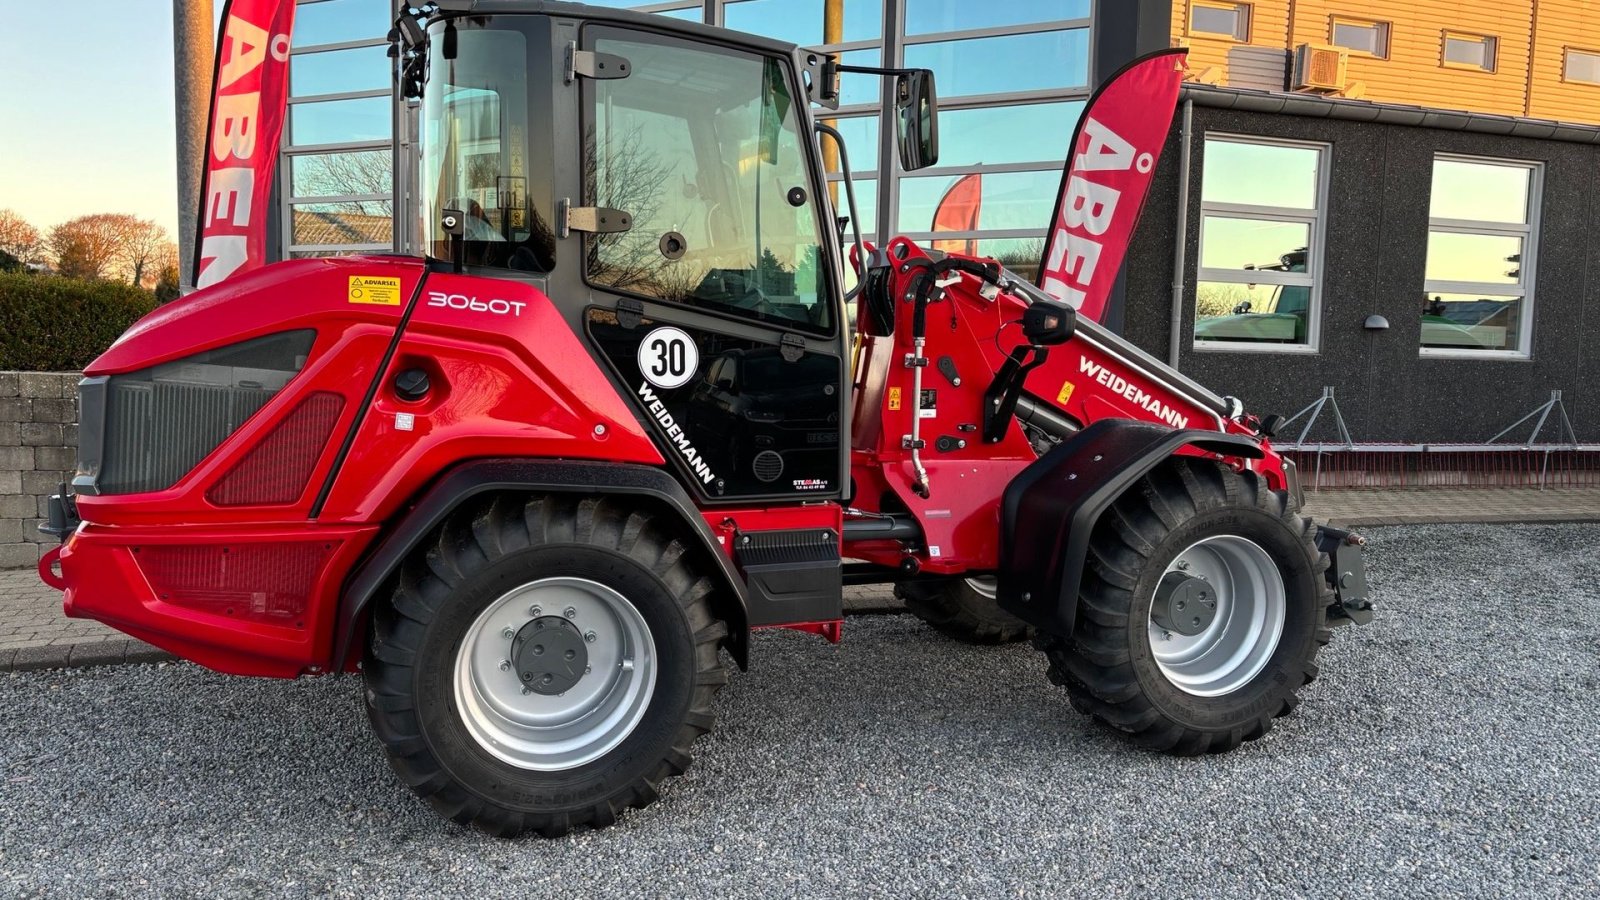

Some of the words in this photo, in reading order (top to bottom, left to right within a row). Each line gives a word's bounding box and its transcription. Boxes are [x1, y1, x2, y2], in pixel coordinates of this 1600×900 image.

[427, 291, 526, 316] 3060T
[651, 338, 686, 377] 30
[1080, 355, 1188, 429] WEIDEMANN
[638, 381, 715, 484] WEIDEMANN
